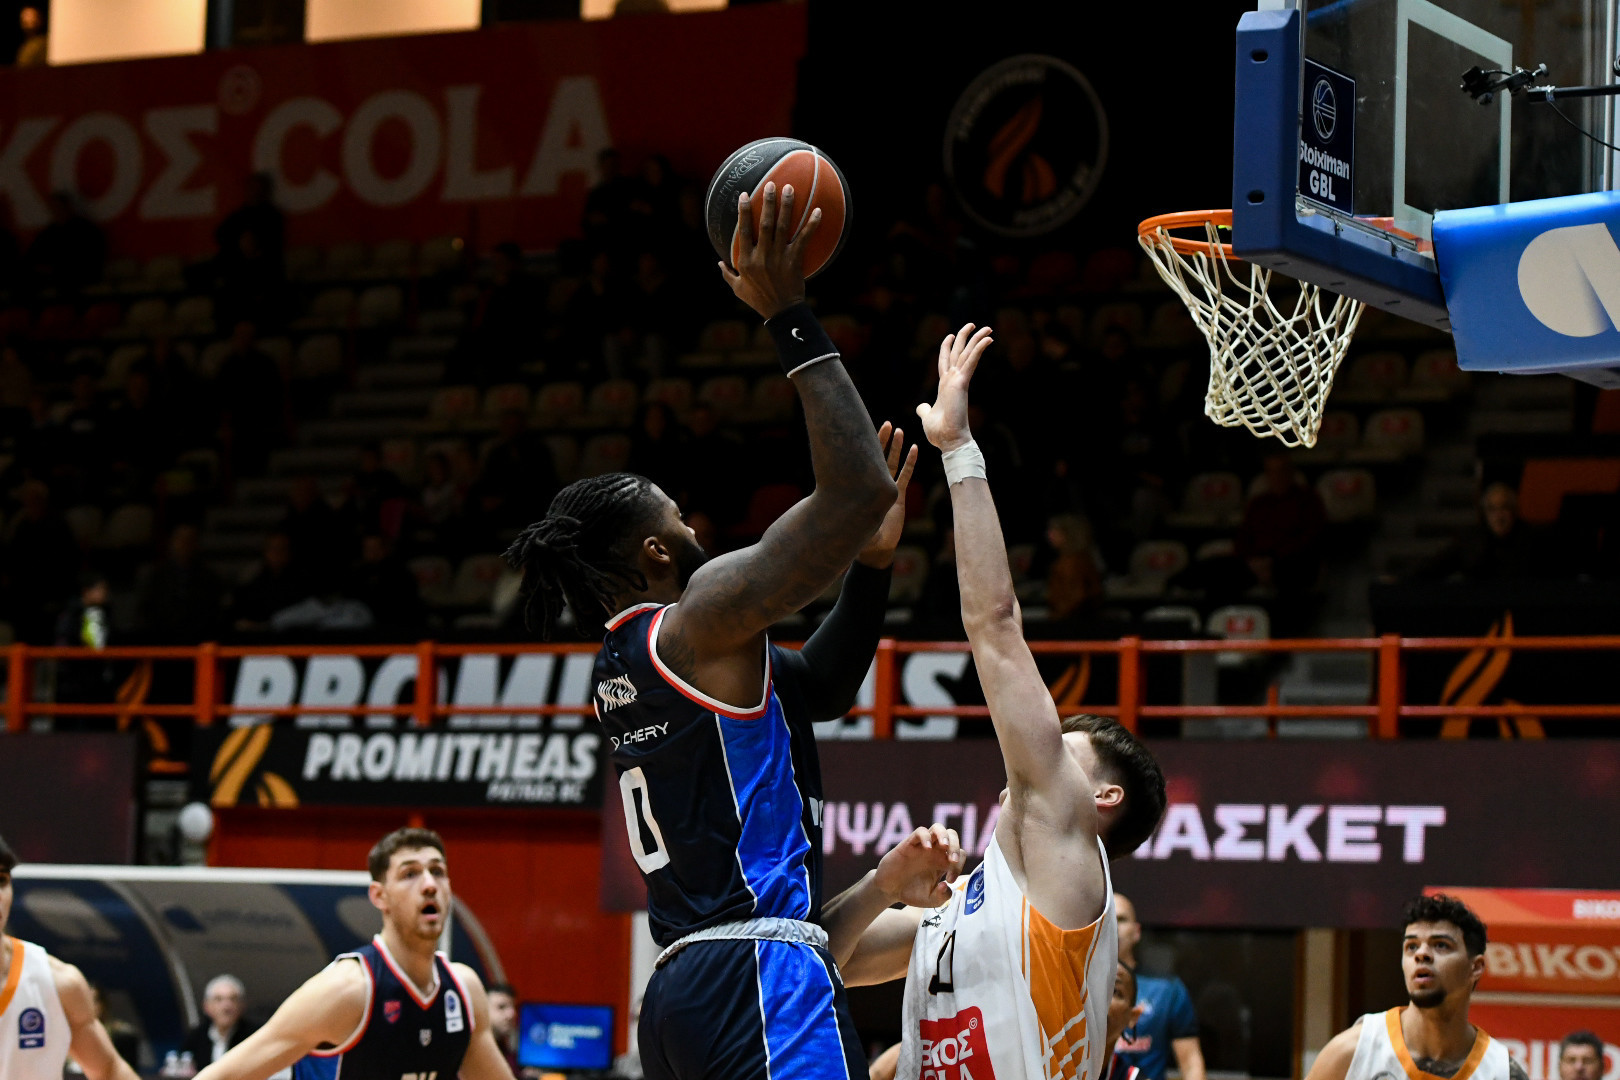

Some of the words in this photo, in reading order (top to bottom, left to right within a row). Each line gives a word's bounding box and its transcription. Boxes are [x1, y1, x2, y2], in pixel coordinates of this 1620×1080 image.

[250, 75, 613, 216] COLA
[1310, 169, 1337, 202] GBL
[302, 732, 600, 782] PROMITHEAS
[623, 721, 669, 745] CHERY
[619, 766, 670, 875] 0
[1131, 802, 1447, 864] ΑΣΚΕΤ
[1485, 940, 1620, 981] ΒΙΚΟ
